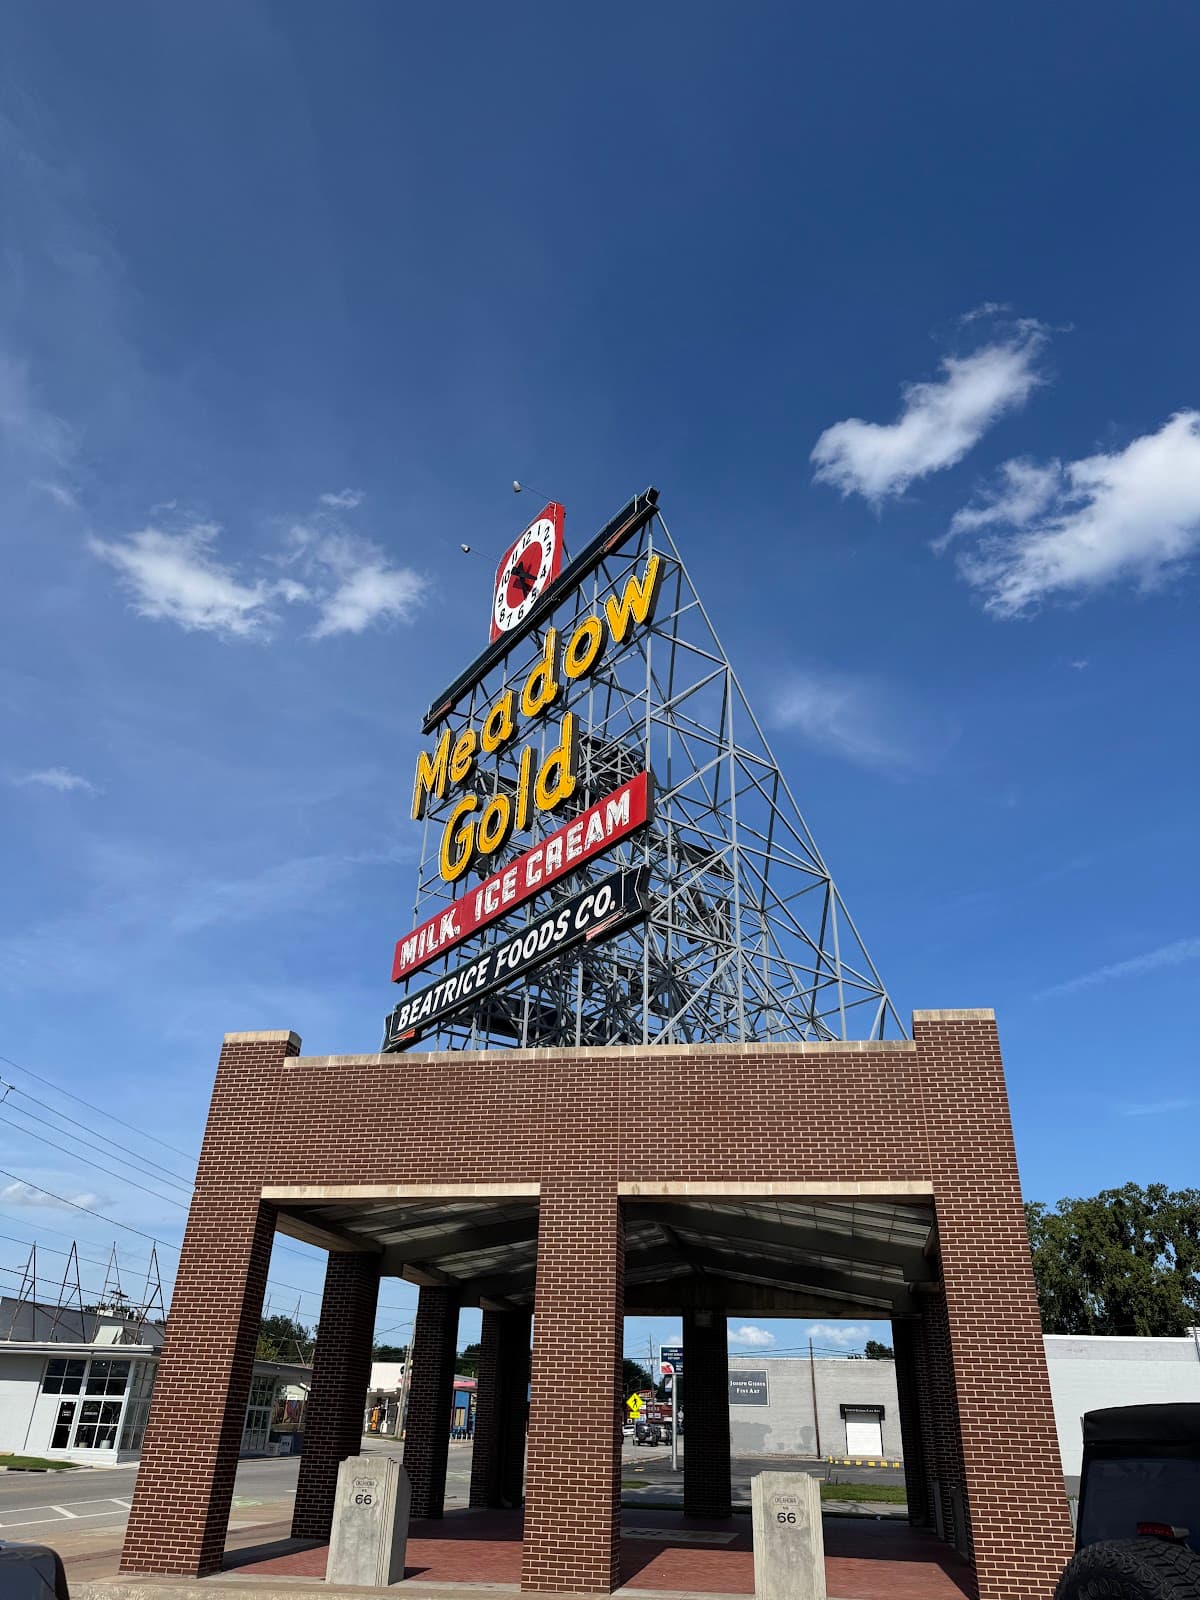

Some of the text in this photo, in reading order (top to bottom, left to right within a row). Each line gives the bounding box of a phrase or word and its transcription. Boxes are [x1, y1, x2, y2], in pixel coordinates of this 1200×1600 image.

[537, 525, 541, 537] 1
[543, 526, 550, 542] 2
[522, 531, 532, 549] 12
[511, 550, 518, 564] 11
[545, 541, 552, 557] 3
[501, 570, 511, 588] 10
[540, 564, 547, 579] 4
[498, 593, 504, 608] 9
[530, 587, 538, 603] 5
[499, 608, 506, 623] 8
[506, 612, 512, 628] 7
[517, 605, 525, 620] 6
[411, 553, 661, 821] Meadow
[438, 710, 578, 882] Gold
[474, 865, 518, 922] ICE
[524, 789, 631, 888] CREAM
[397, 884, 617, 1031] BEATRICE FOODS CO.
[355, 1494, 372, 1505] 66
[777, 1512, 797, 1524] 66
